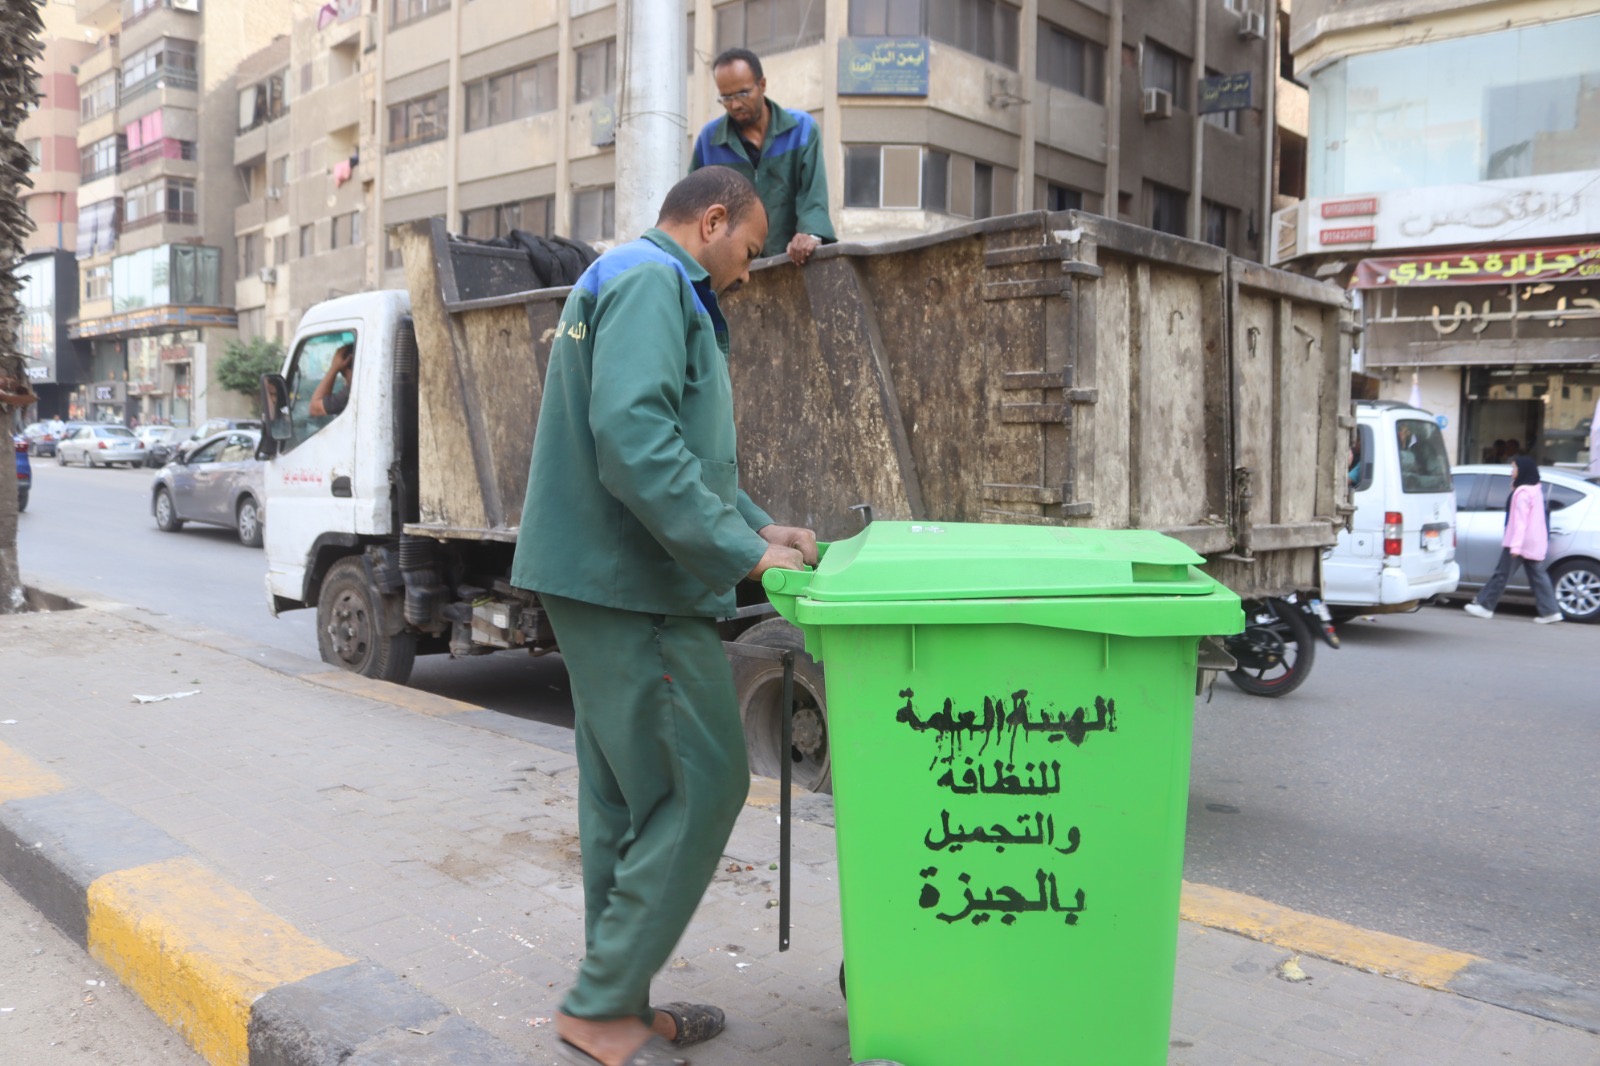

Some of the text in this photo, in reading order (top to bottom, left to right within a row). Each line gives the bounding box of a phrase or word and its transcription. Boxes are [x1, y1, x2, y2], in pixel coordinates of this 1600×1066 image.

[1389, 255, 1479, 285] خيري
[1485, 251, 1577, 278] جزارة
[936, 756, 1061, 795] للنظافة
[924, 808, 1081, 855] والتجميل
[918, 866, 1087, 926] بالجيزة
